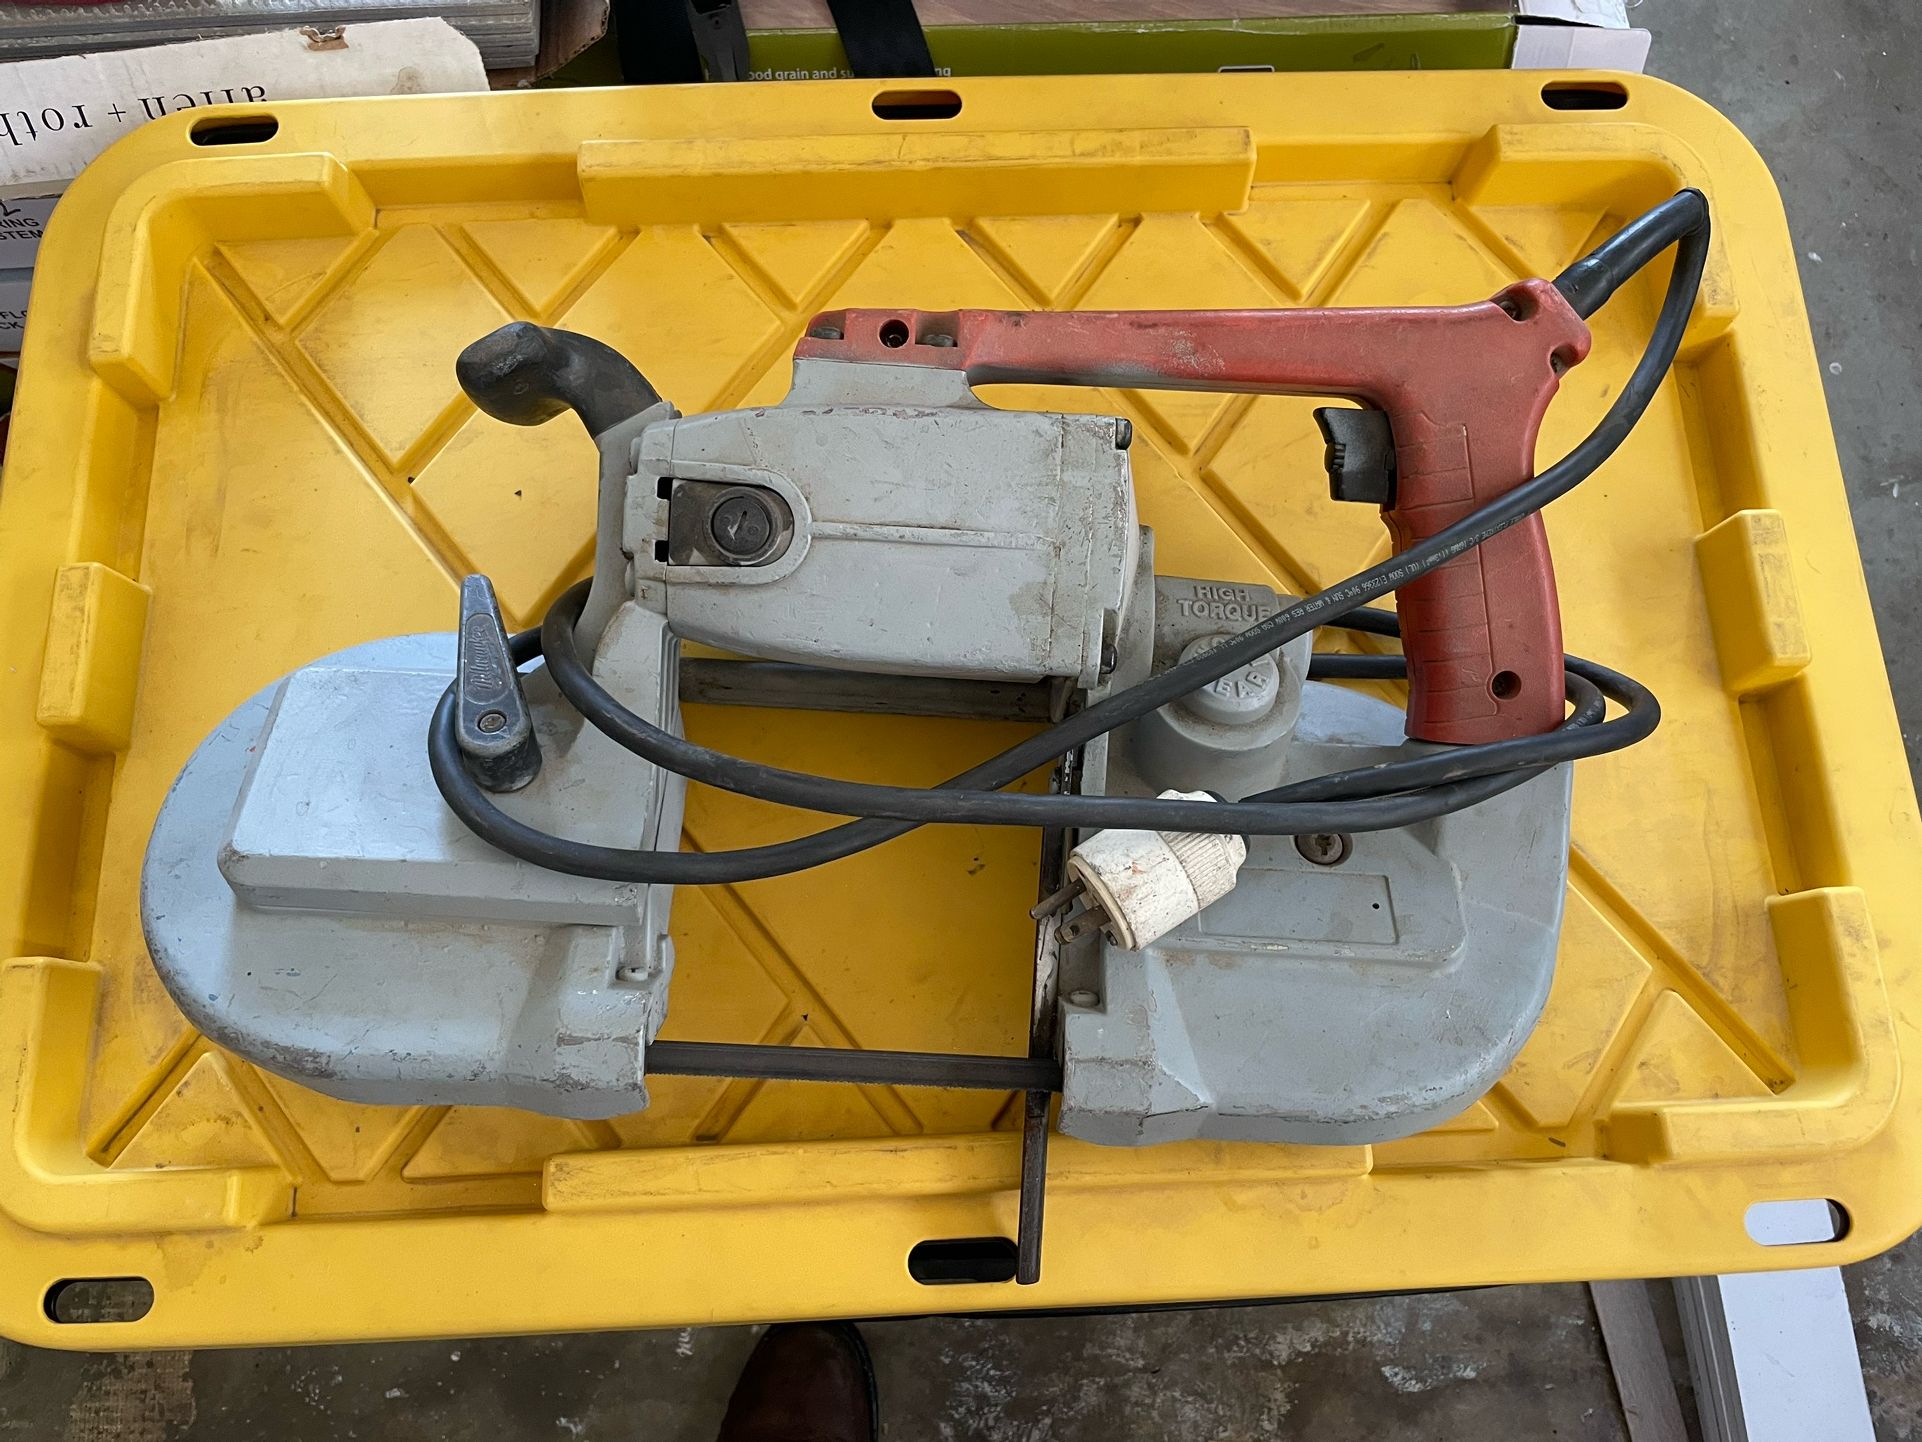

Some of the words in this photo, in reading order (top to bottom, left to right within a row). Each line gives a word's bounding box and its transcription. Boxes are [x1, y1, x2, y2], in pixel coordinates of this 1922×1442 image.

[747, 68, 772, 80] ood
[775, 68, 809, 81] grain
[812, 67, 837, 79] and
[1194, 585, 1250, 602] HIGH
[1178, 599, 1273, 622] TORQUE
[1291, 606, 1305, 618] RES
[1304, 598, 1324, 613] WATER
[1214, 670, 1270, 698] EAR
